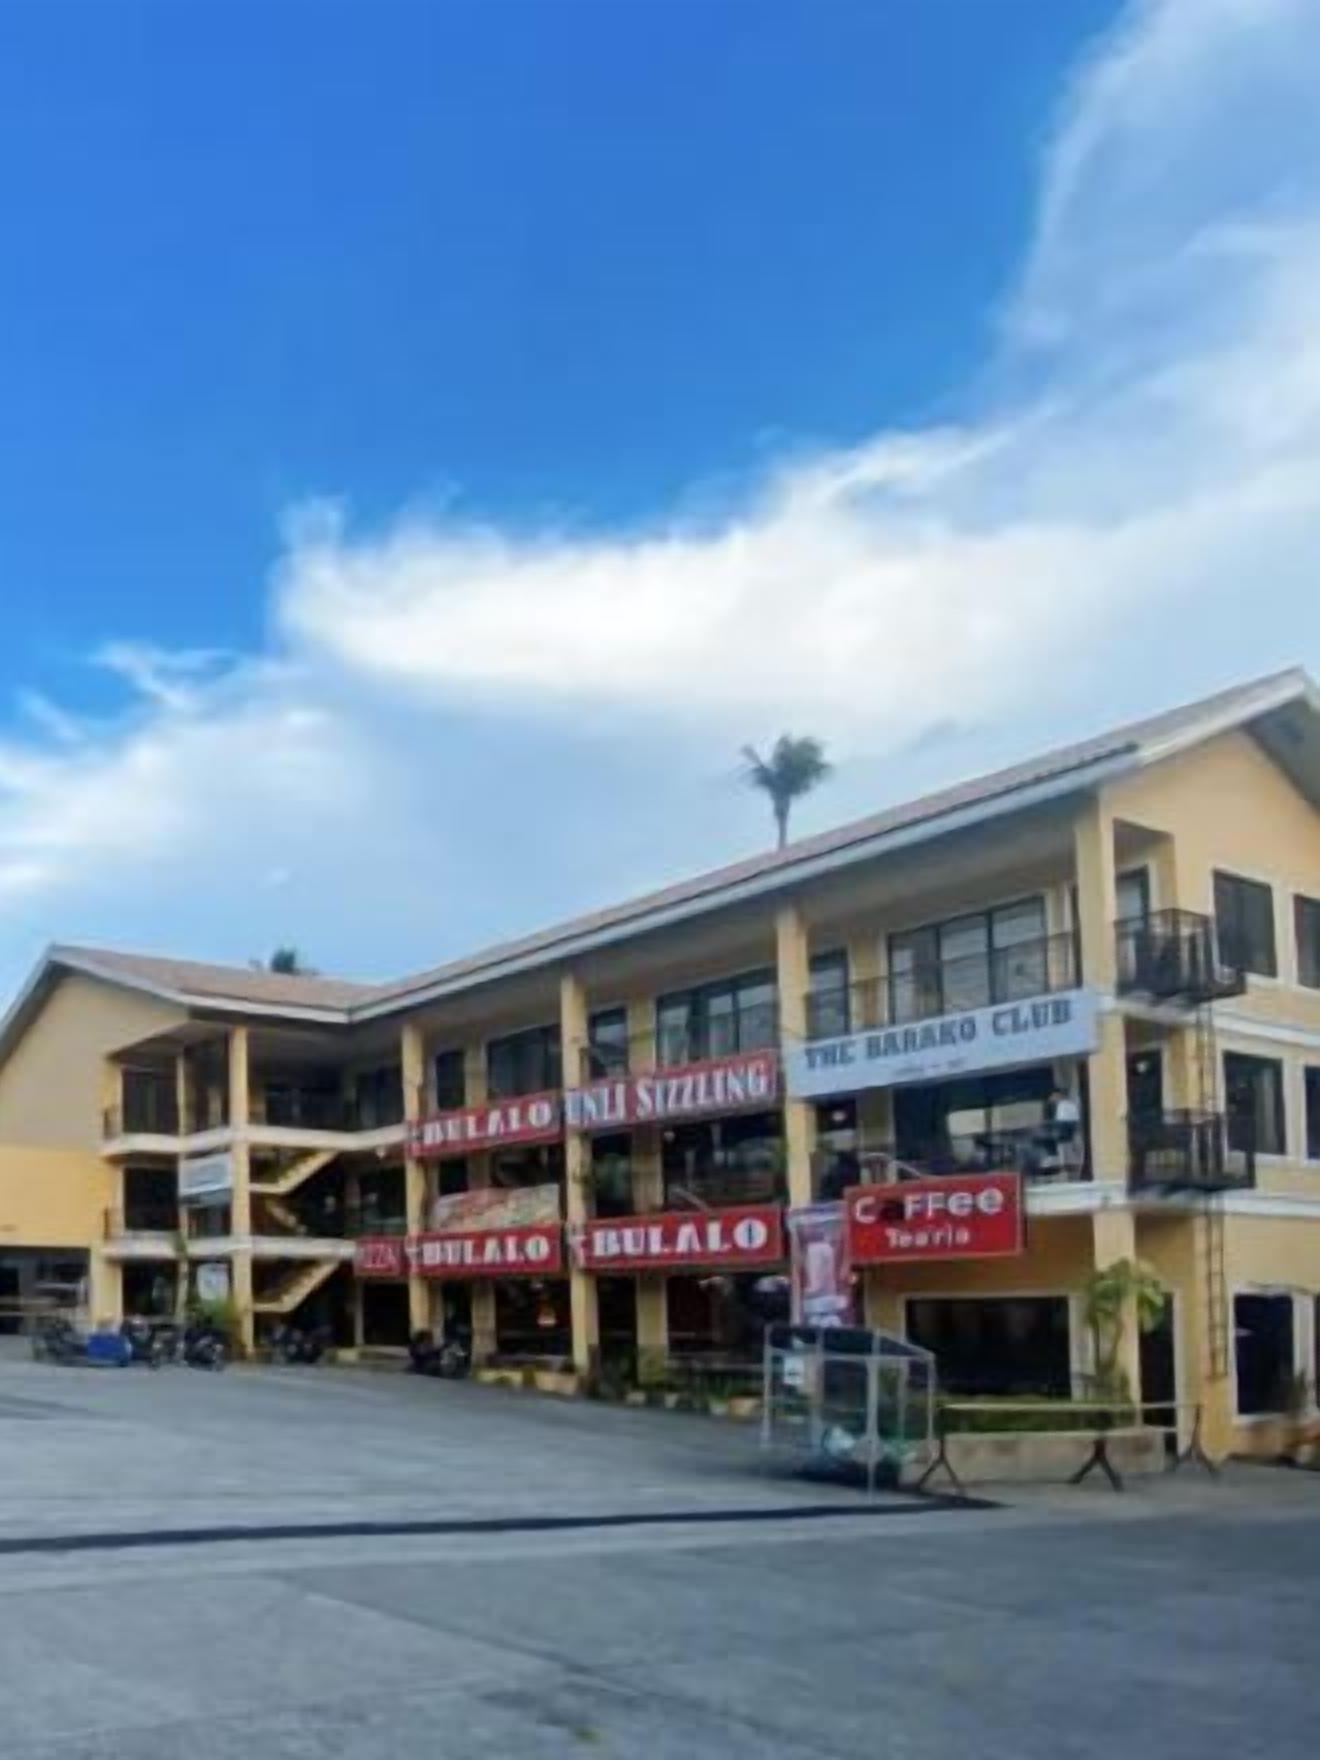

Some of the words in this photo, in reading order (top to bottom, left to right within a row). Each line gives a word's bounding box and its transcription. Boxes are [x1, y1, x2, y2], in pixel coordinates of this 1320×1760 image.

[805, 1040, 856, 1068] THE
[865, 1016, 976, 1060] BARAKO
[992, 1000, 1071, 1035] CLUB
[635, 1060, 767, 1118] SIZZLING
[423, 1102, 552, 1145] BULALO
[422, 1235, 550, 1265] BULALO
[592, 1218, 767, 1256] BULALO
